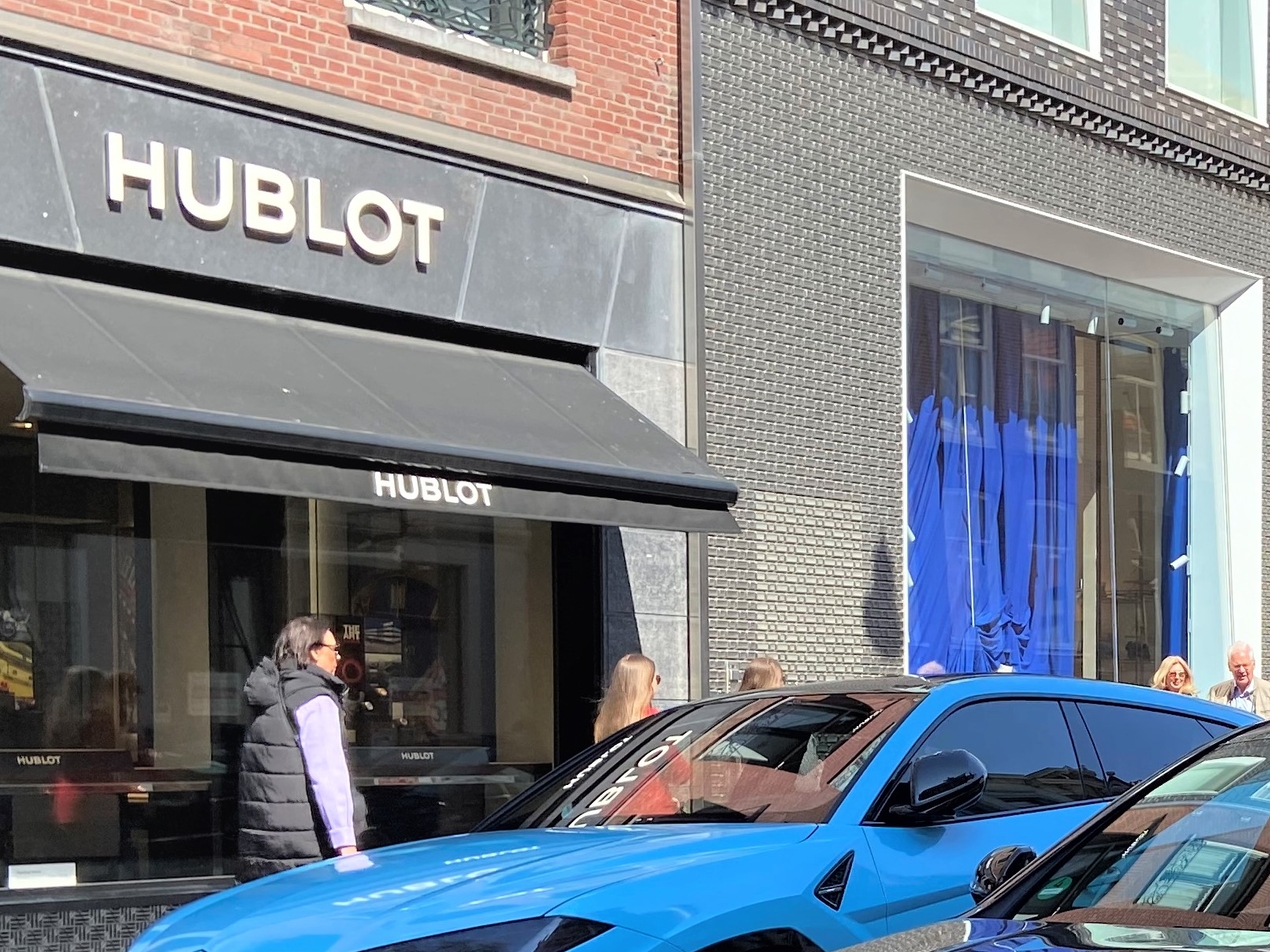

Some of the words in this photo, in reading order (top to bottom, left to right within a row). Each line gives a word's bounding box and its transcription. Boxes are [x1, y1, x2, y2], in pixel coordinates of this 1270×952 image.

[106, 131, 444, 268] HUBLOT
[373, 472, 493, 507] HUBLOT
[17, 755, 62, 766] HUBLOT
[401, 752, 434, 760] HUBLOT
